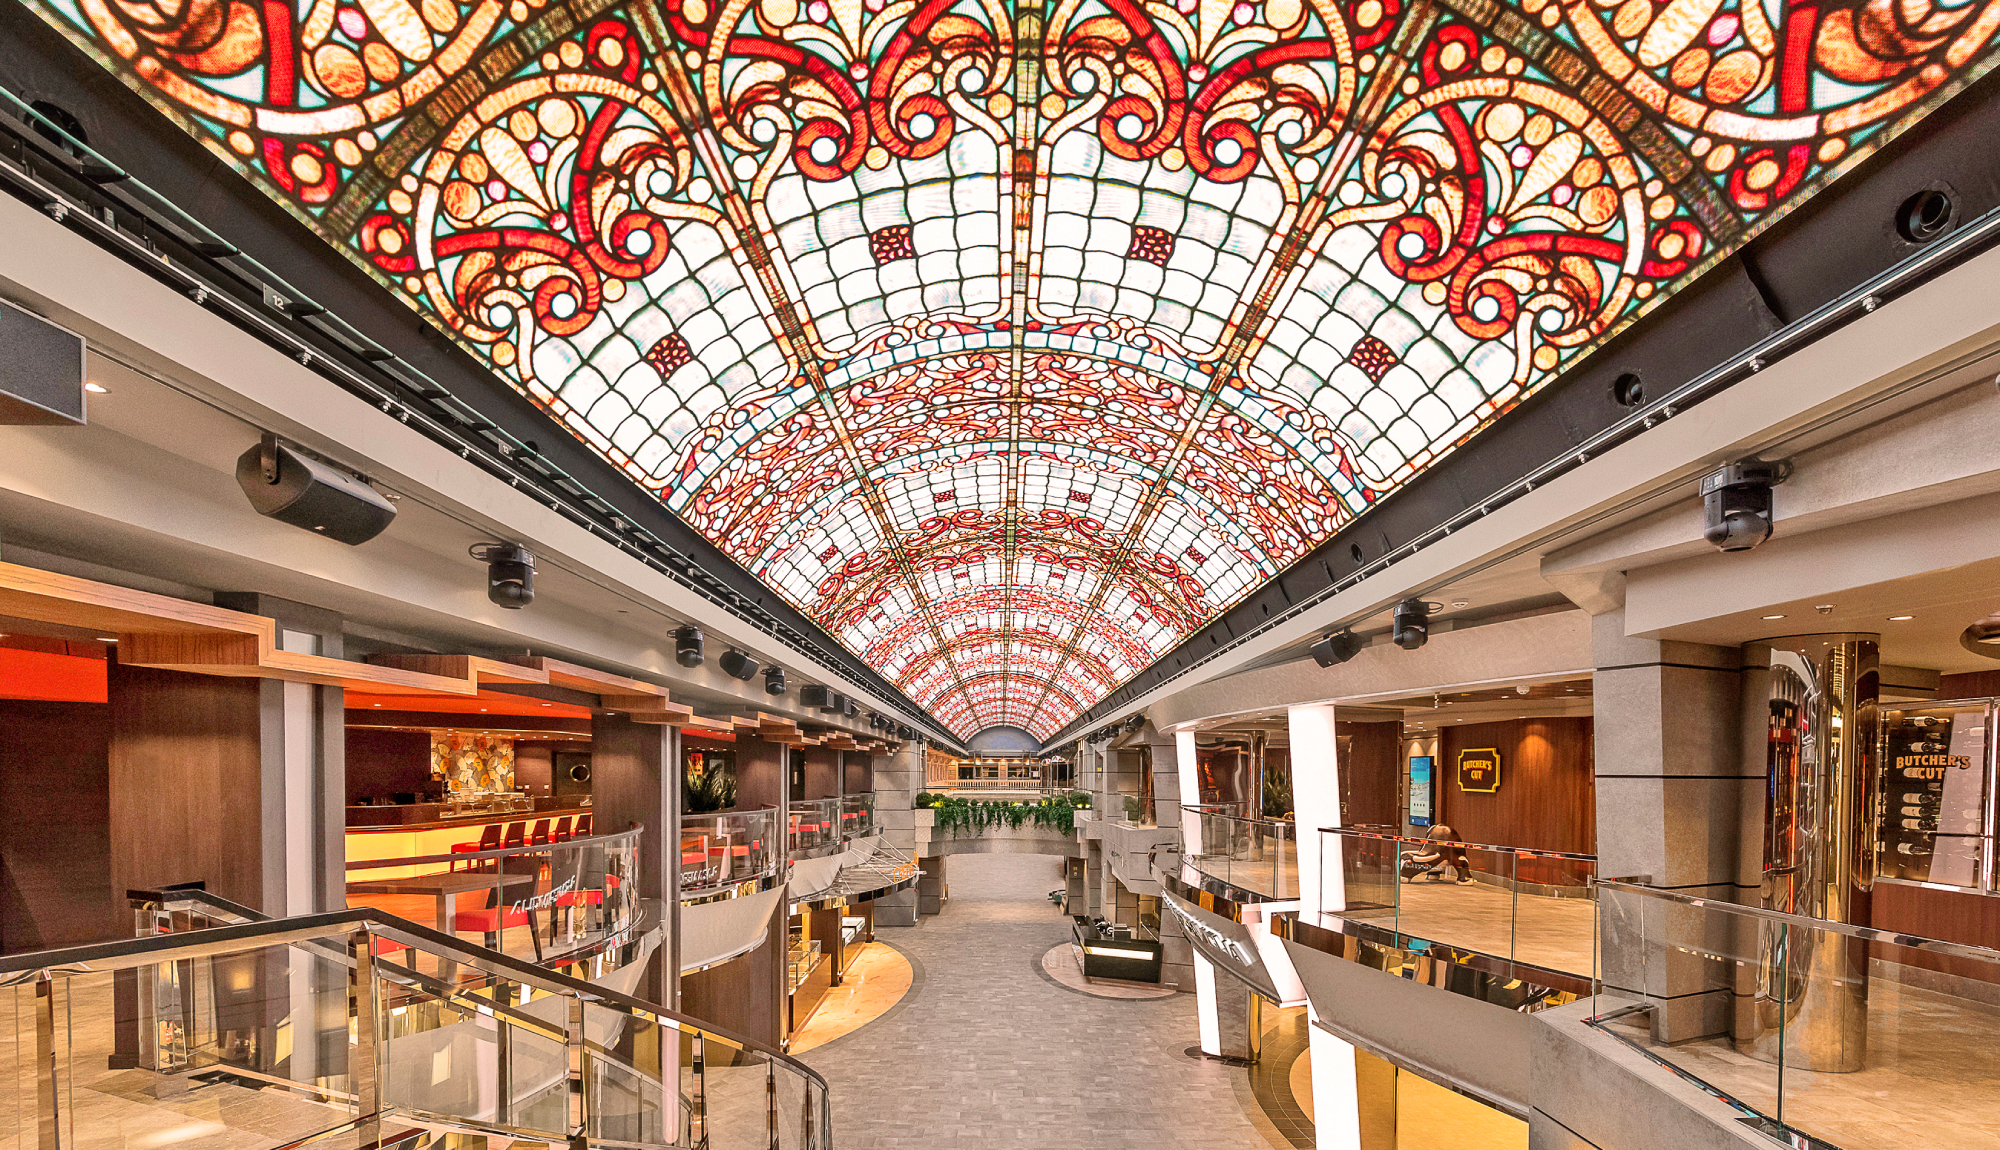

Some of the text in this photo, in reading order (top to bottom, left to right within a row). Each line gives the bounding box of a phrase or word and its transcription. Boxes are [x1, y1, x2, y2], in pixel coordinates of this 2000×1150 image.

[272, 295, 284, 310] 12
[1463, 760, 1492, 771] BUTCHER'S
[1896, 754, 1971, 769] BUTCHER'S
[1471, 770, 1483, 780] CUT
[1917, 767, 1944, 779] CUT
